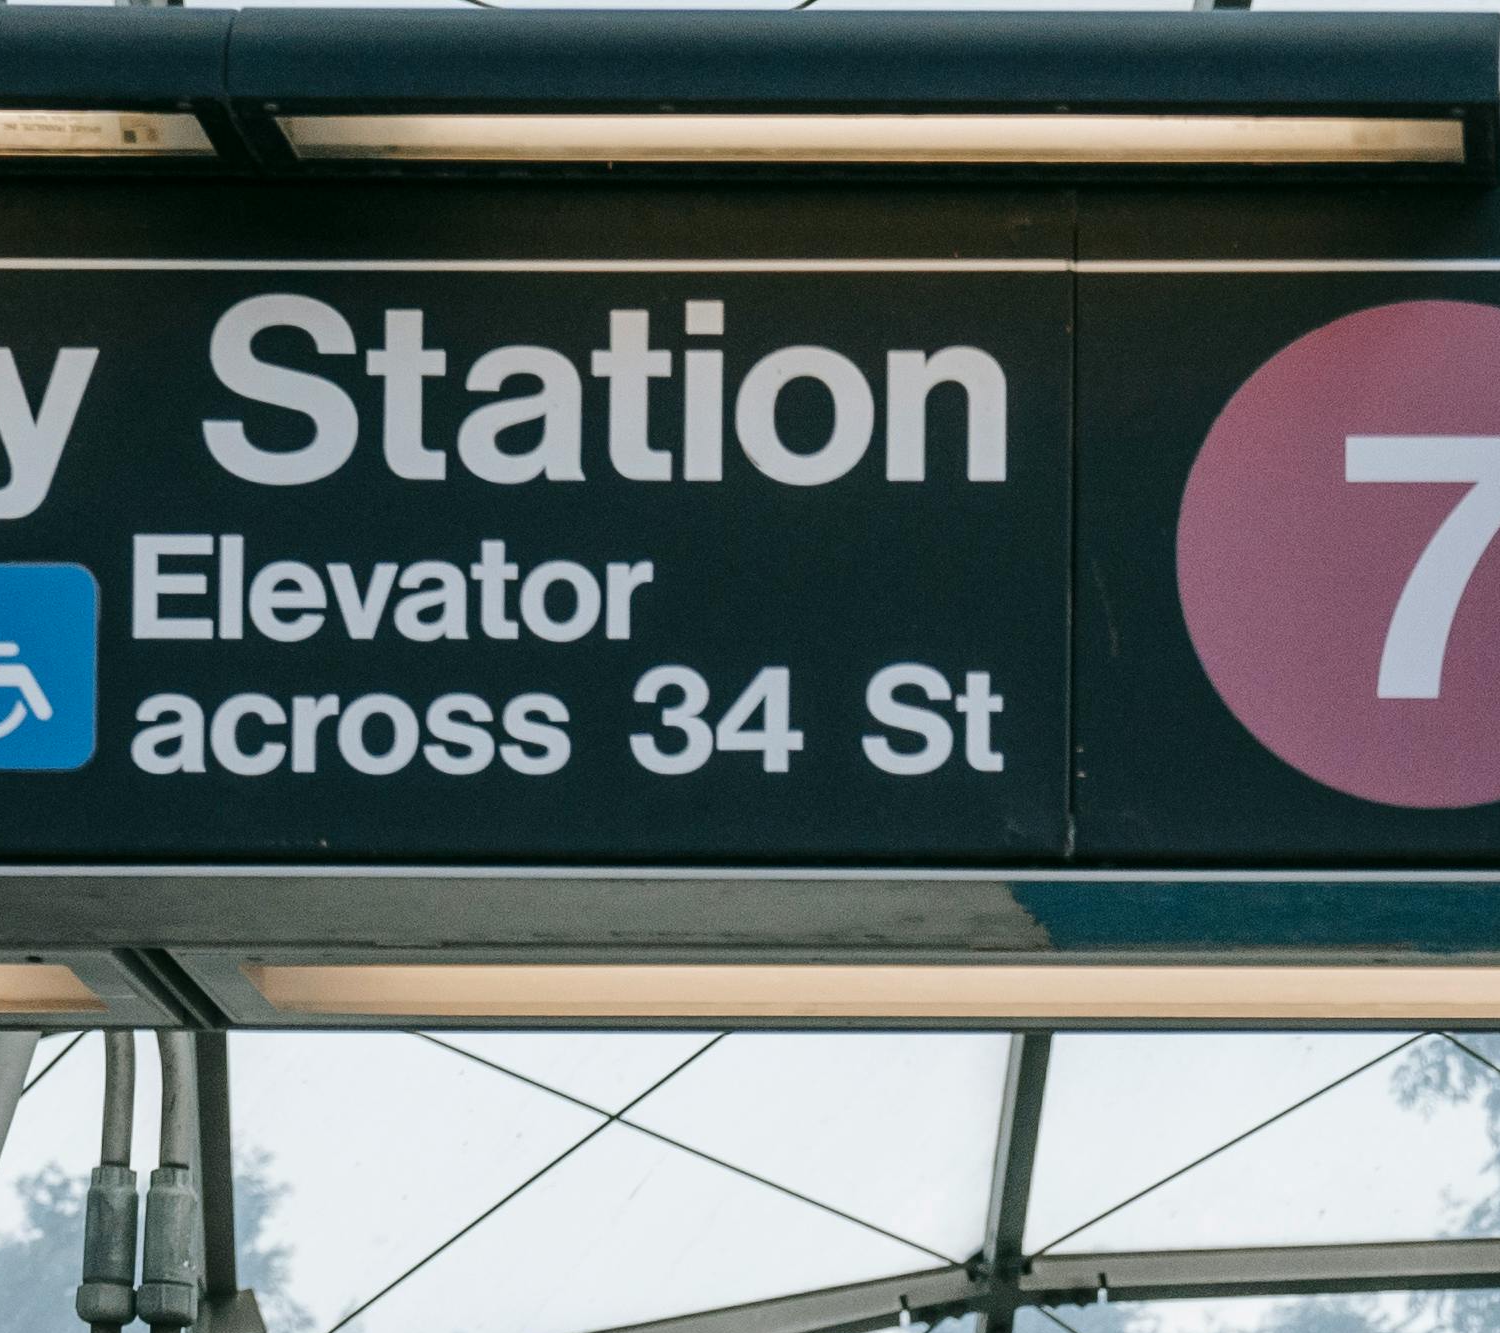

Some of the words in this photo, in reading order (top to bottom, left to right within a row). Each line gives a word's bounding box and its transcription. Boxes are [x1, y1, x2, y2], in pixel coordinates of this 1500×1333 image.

[202, 294, 1007, 487] Station
[132, 533, 654, 643] Elevator
[130, 692, 571, 776] across
[629, 665, 804, 775] 34
[861, 662, 1004, 776] St
